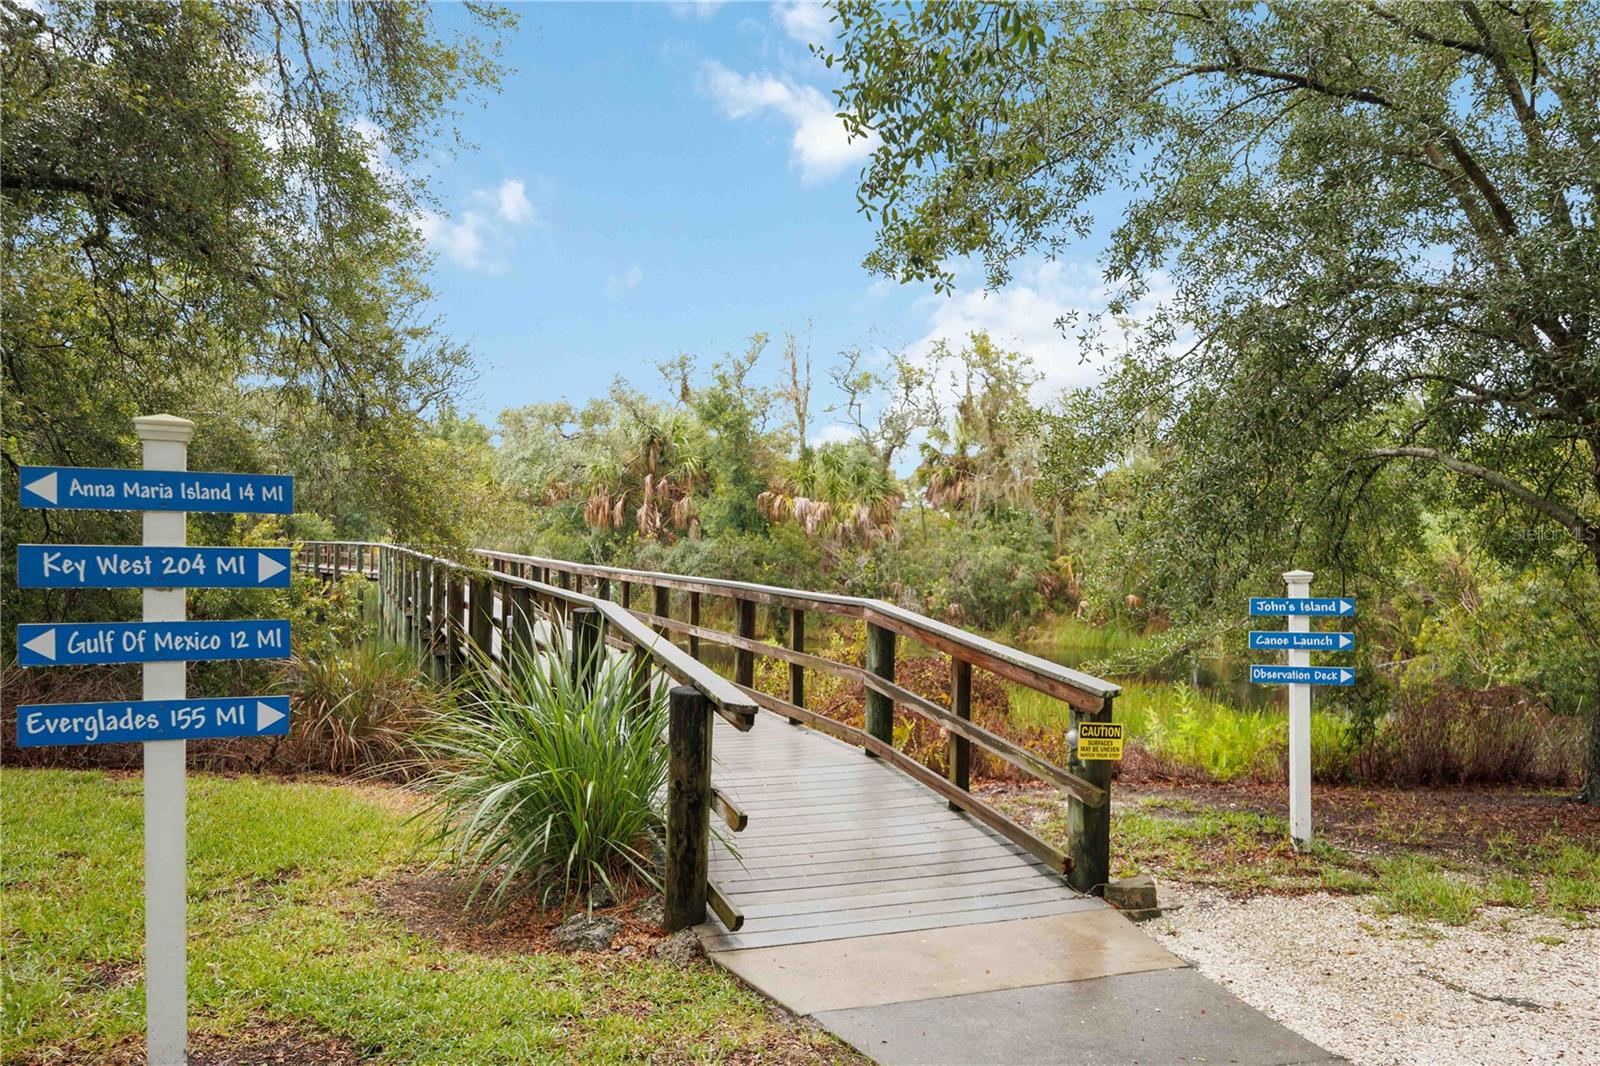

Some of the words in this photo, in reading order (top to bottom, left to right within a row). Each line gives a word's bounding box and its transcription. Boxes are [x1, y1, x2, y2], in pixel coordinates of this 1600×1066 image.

[69, 478, 115, 498] Anna
[123, 482, 173, 500] Maria
[180, 482, 231, 501] Island
[238, 483, 255, 501] 14
[262, 485, 284, 502] MI
[42, 552, 87, 582] Key
[96, 552, 152, 575] West
[162, 553, 206, 575] 204
[217, 555, 245, 575] MI
[1256, 600, 1296, 612] John's
[1300, 601, 1336, 612] Island
[67, 629, 115, 655] Gulf
[122, 629, 147, 652] Of
[154, 631, 221, 652] Mexico
[230, 631, 249, 649] 12
[257, 627, 282, 648] MI
[1256, 635, 1289, 645] Canoe
[1293, 635, 1333, 646] Launch
[1253, 669, 1311, 680] Observation
[1314, 670, 1338, 680] Deck
[26, 707, 160, 740] Everglades
[170, 706, 206, 729] 155
[216, 704, 245, 726] MI
[1081, 726, 1121, 737] CAUTION
